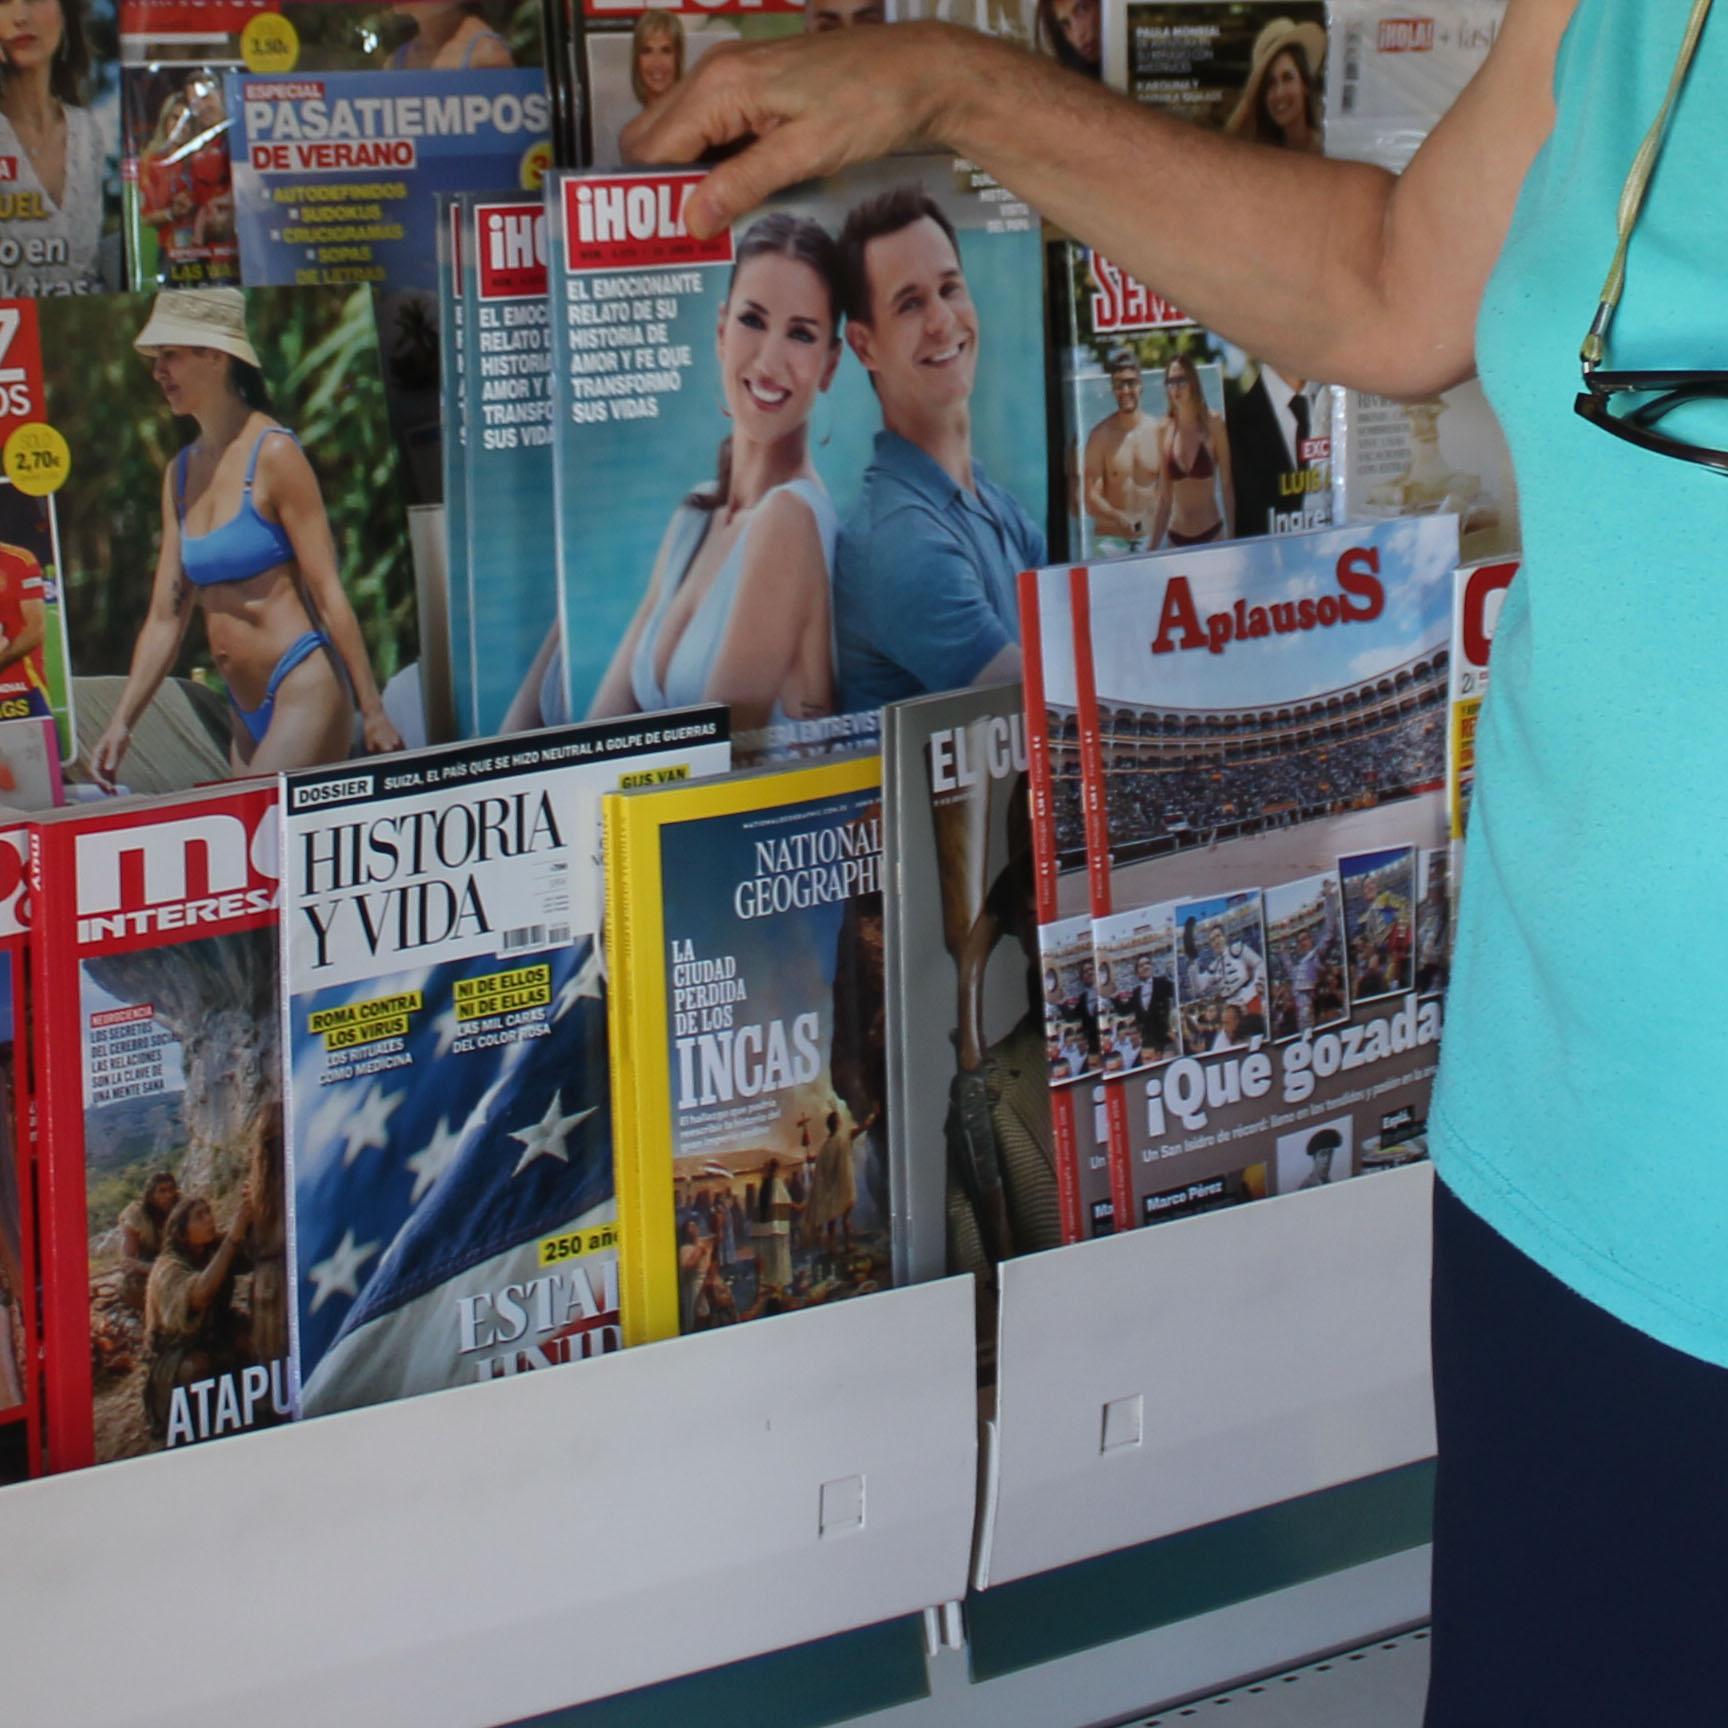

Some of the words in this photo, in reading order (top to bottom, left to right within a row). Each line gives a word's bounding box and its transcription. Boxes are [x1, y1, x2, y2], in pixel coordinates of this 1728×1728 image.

[245, 94, 549, 142] PASATIEMPOS
[252, 145, 289, 169] DE
[295, 142, 414, 168] VERANO
[29, 241, 68, 266] en
[15, 449, 61, 472] 2,70€
[298, 778, 369, 805] DOSSIER
[299, 790, 567, 897] HISTORIA
[300, 899, 342, 969] Y
[353, 873, 495, 955] VIDA
[672, 939, 694, 964] LA
[673, 956, 737, 988] CIUDAD
[674, 978, 747, 1013] PERDIDA
[311, 1008, 358, 1031] ROMA
[360, 994, 419, 1021] CONTRA
[676, 1012, 699, 1036] DE
[701, 1005, 734, 1032] LOS
[327, 1029, 356, 1047] LOS
[360, 1018, 404, 1040] VIRUS
[676, 1011, 820, 1110] INCAS
[1145, 1034, 1272, 1138] ¡Qué
[1282, 992, 1441, 1104] gozada
